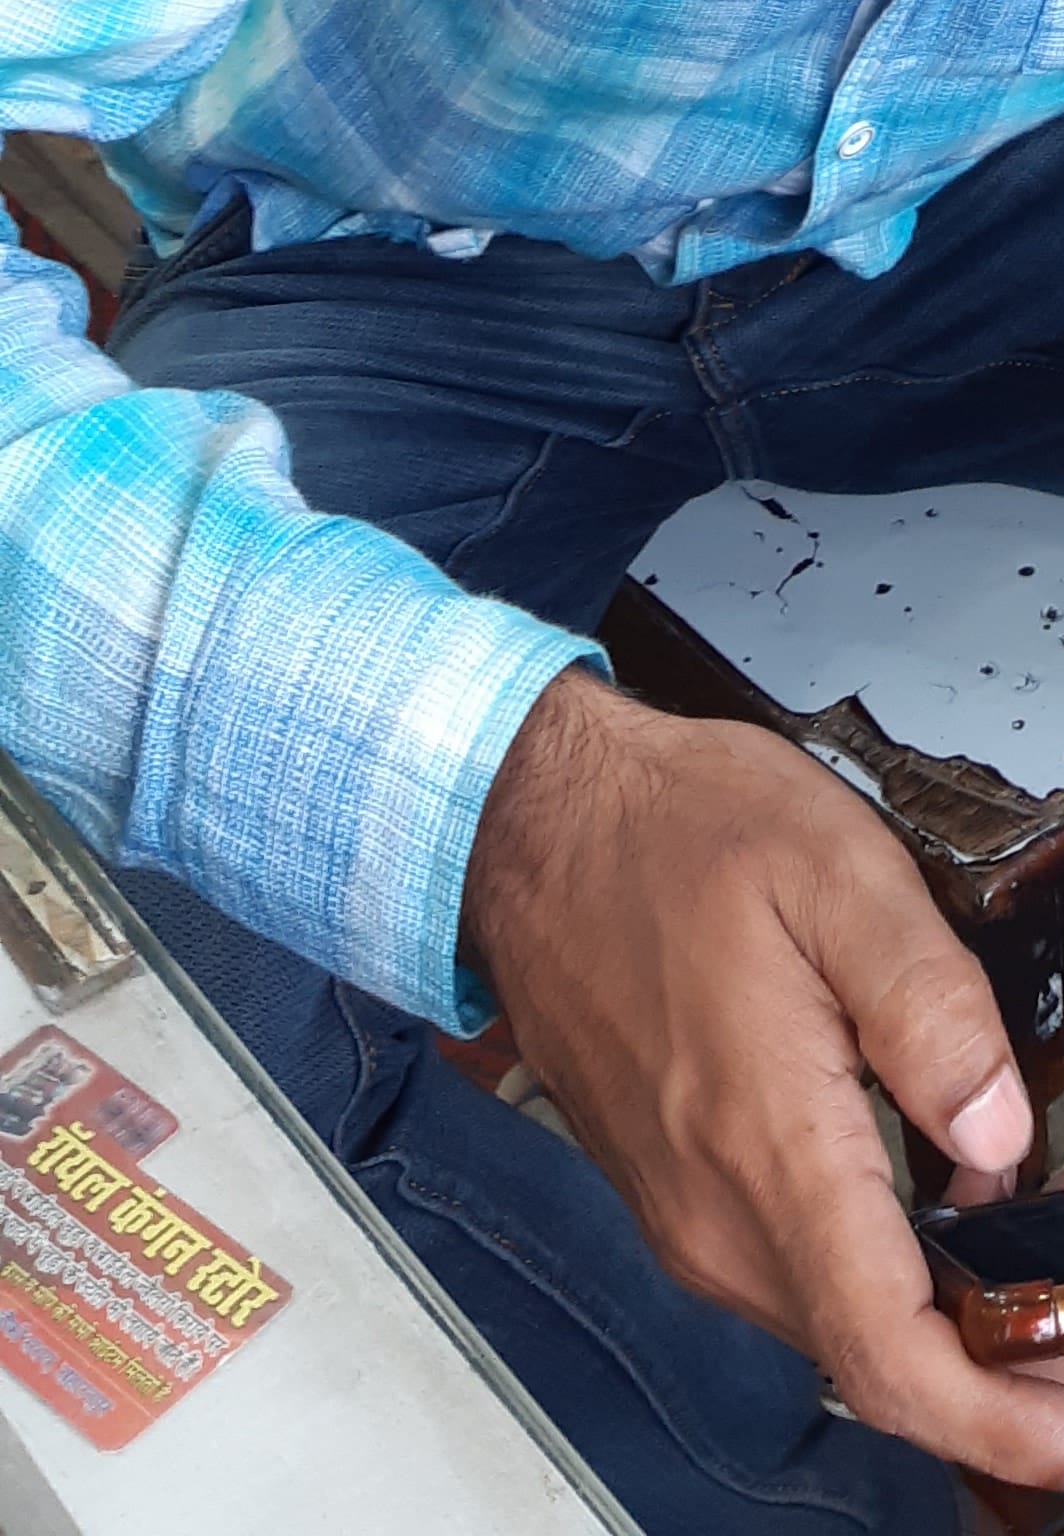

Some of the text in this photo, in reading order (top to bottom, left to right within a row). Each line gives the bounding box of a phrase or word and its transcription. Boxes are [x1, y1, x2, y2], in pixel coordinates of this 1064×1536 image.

[27, 1121, 279, 1329] रॉयल कंगन स्टोर
